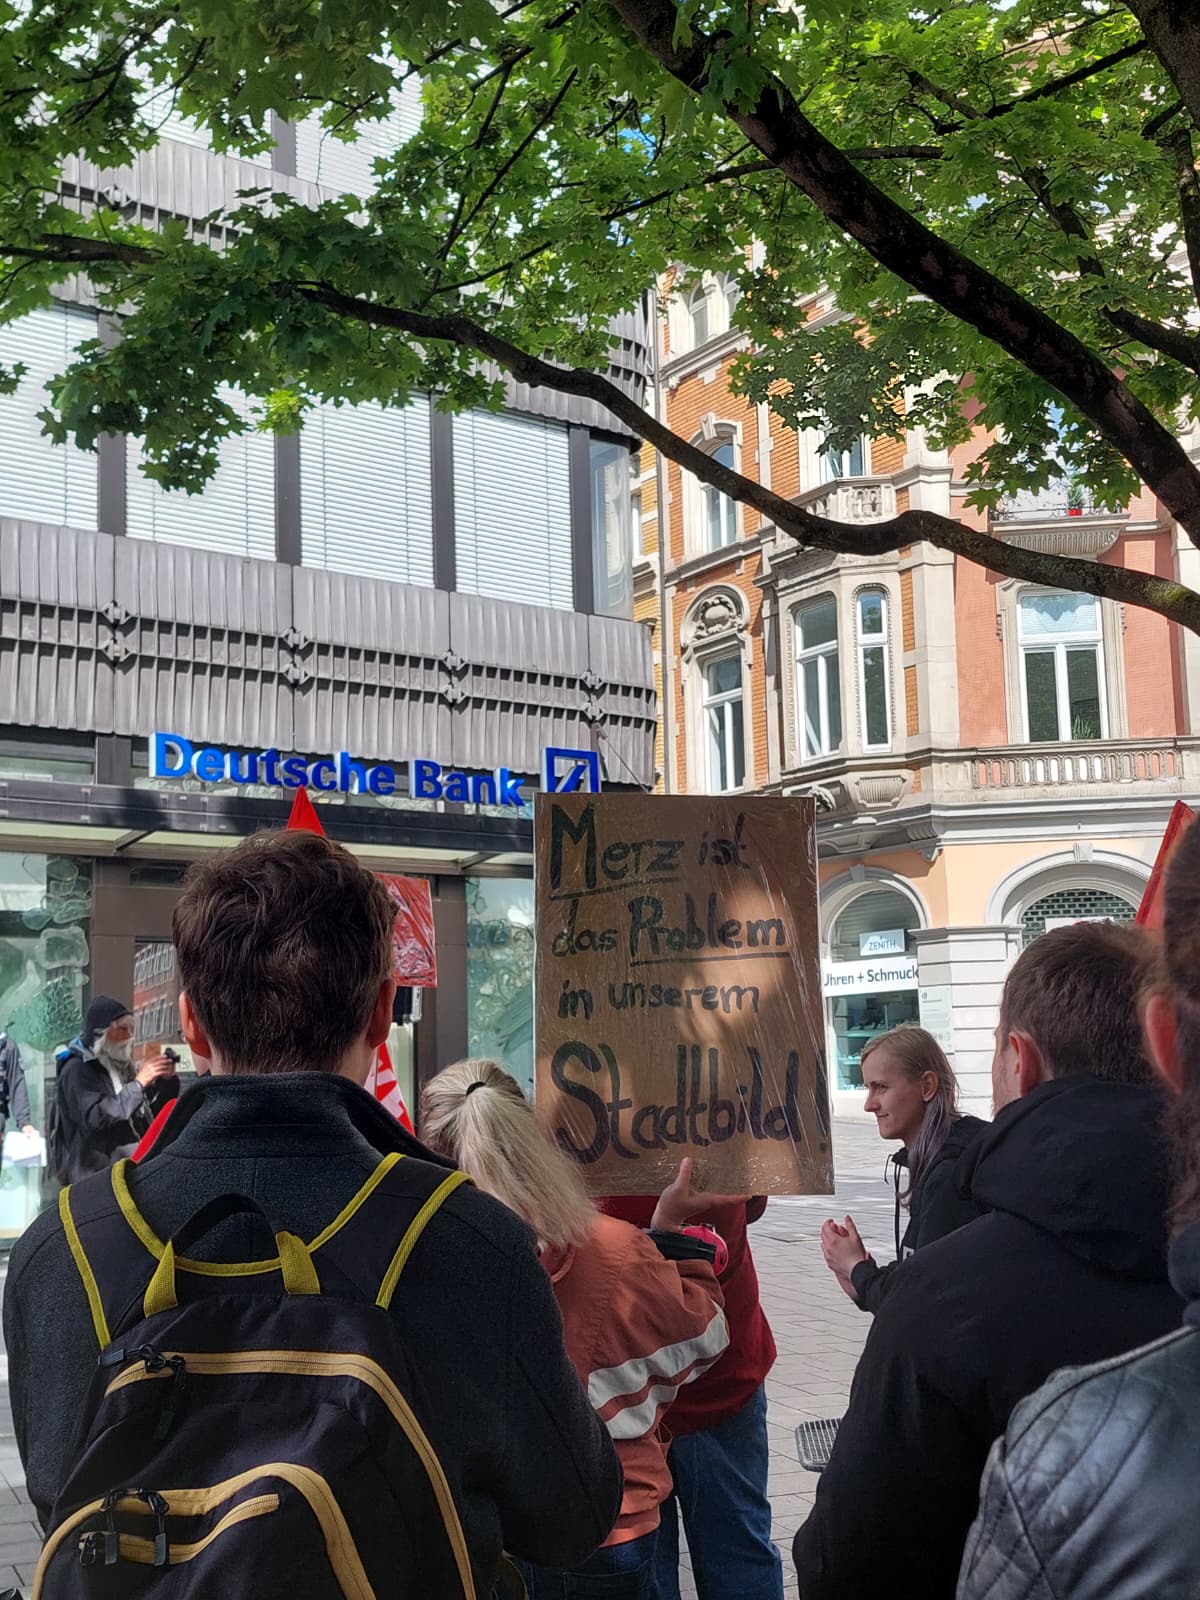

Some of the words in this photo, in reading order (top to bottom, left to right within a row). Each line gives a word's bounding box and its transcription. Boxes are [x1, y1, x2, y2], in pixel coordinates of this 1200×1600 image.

[148, 731, 396, 797] Deutsche
[409, 759, 525, 806] Bank
[550, 803, 685, 890] Merz
[698, 813, 751, 870] ist
[552, 899, 618, 957] das
[629, 892, 786, 957] Problem
[869, 939, 896, 951] ZENITH
[558, 980, 593, 1019] in
[608, 980, 760, 1013] unserem
[867, 965, 919, 982] Schmuck
